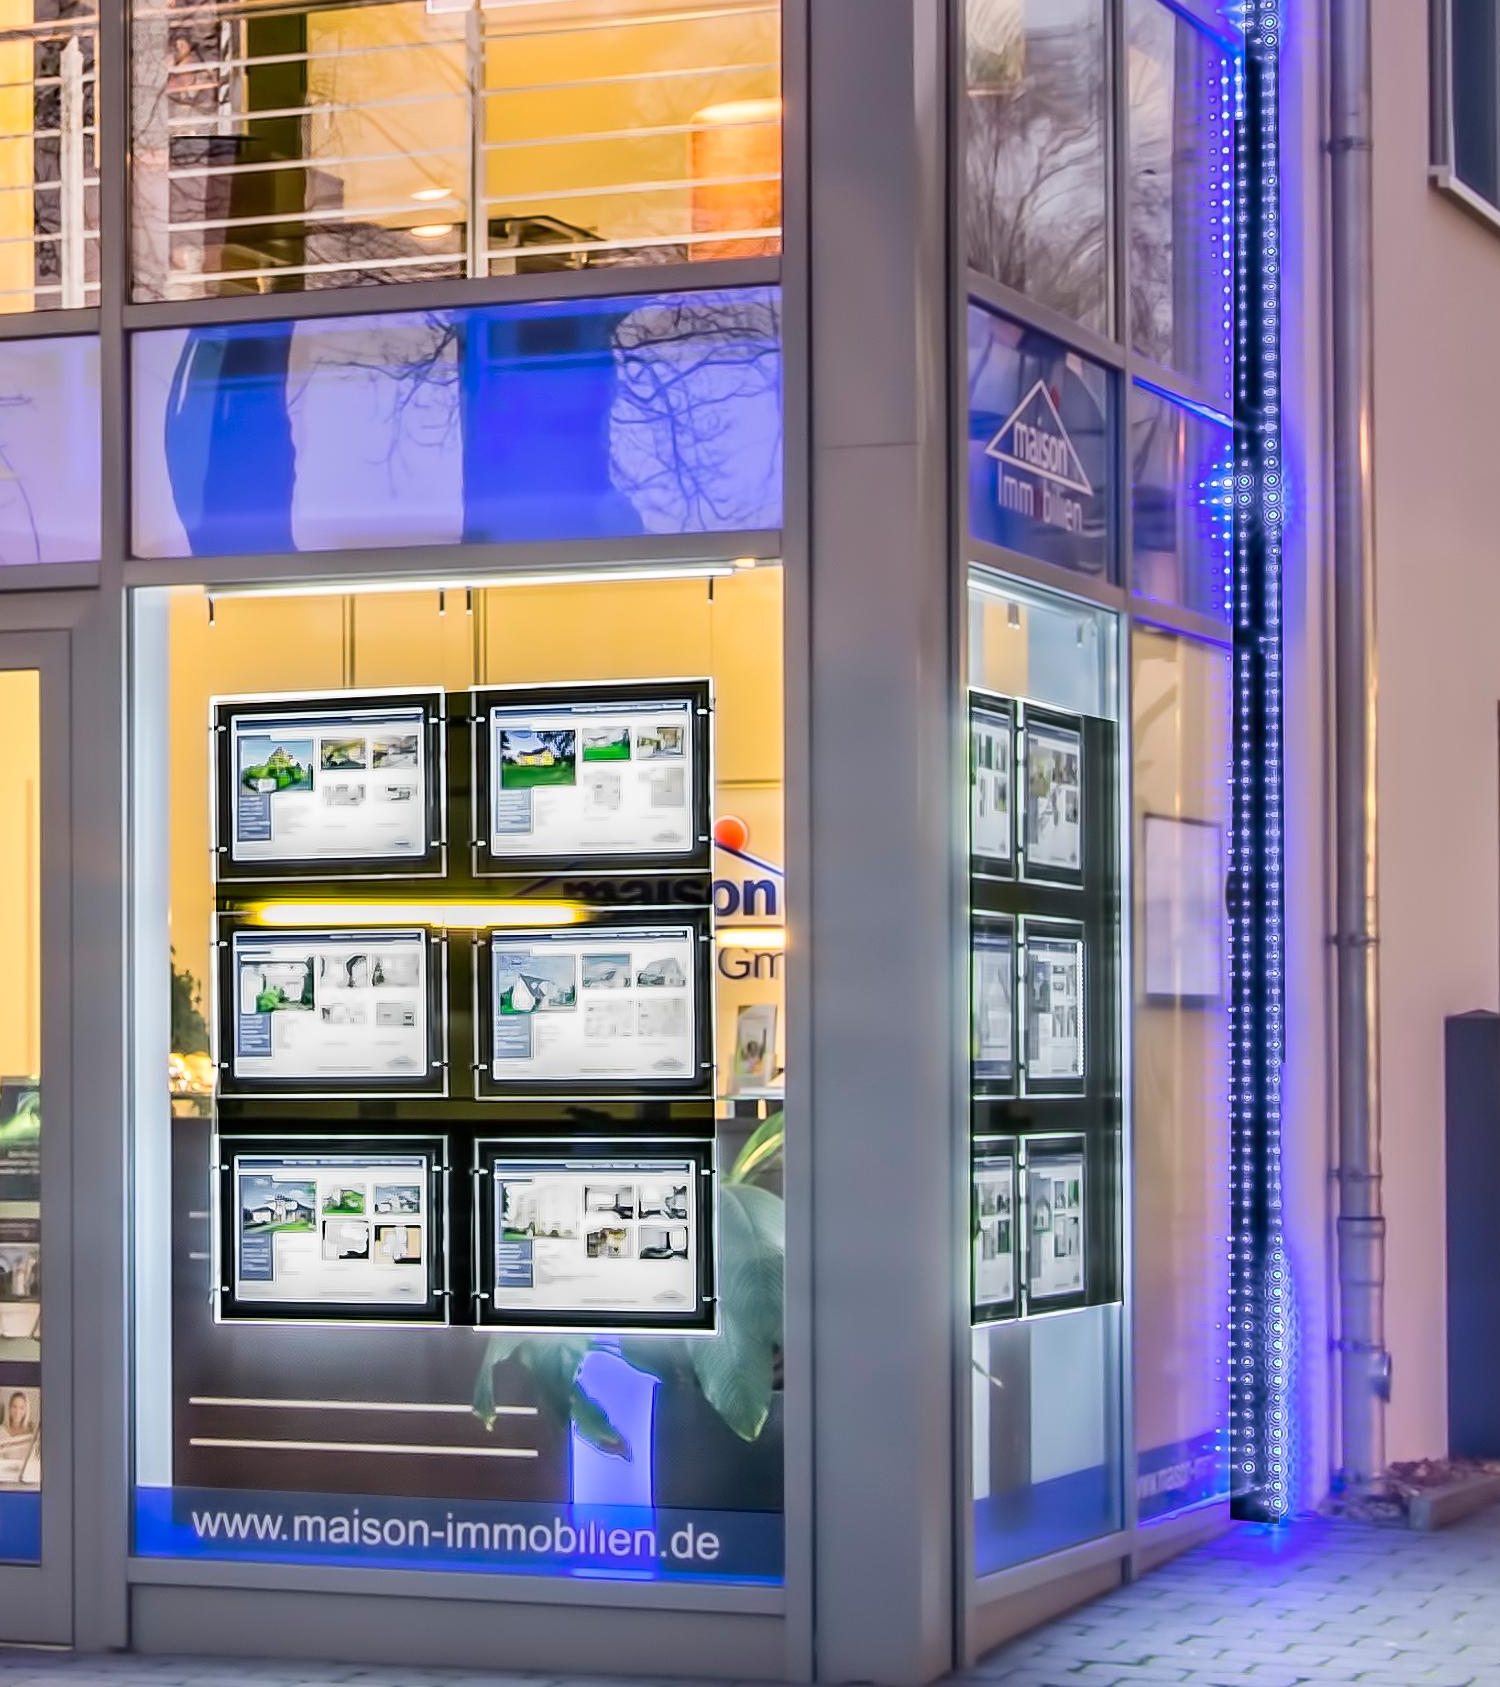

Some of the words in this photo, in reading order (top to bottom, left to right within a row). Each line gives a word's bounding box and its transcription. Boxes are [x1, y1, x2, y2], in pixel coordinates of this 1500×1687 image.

[1013, 416, 1068, 477] maison
[562, 878, 777, 917] maison
[192, 1508, 721, 1561] www.maison-immobilien.de
